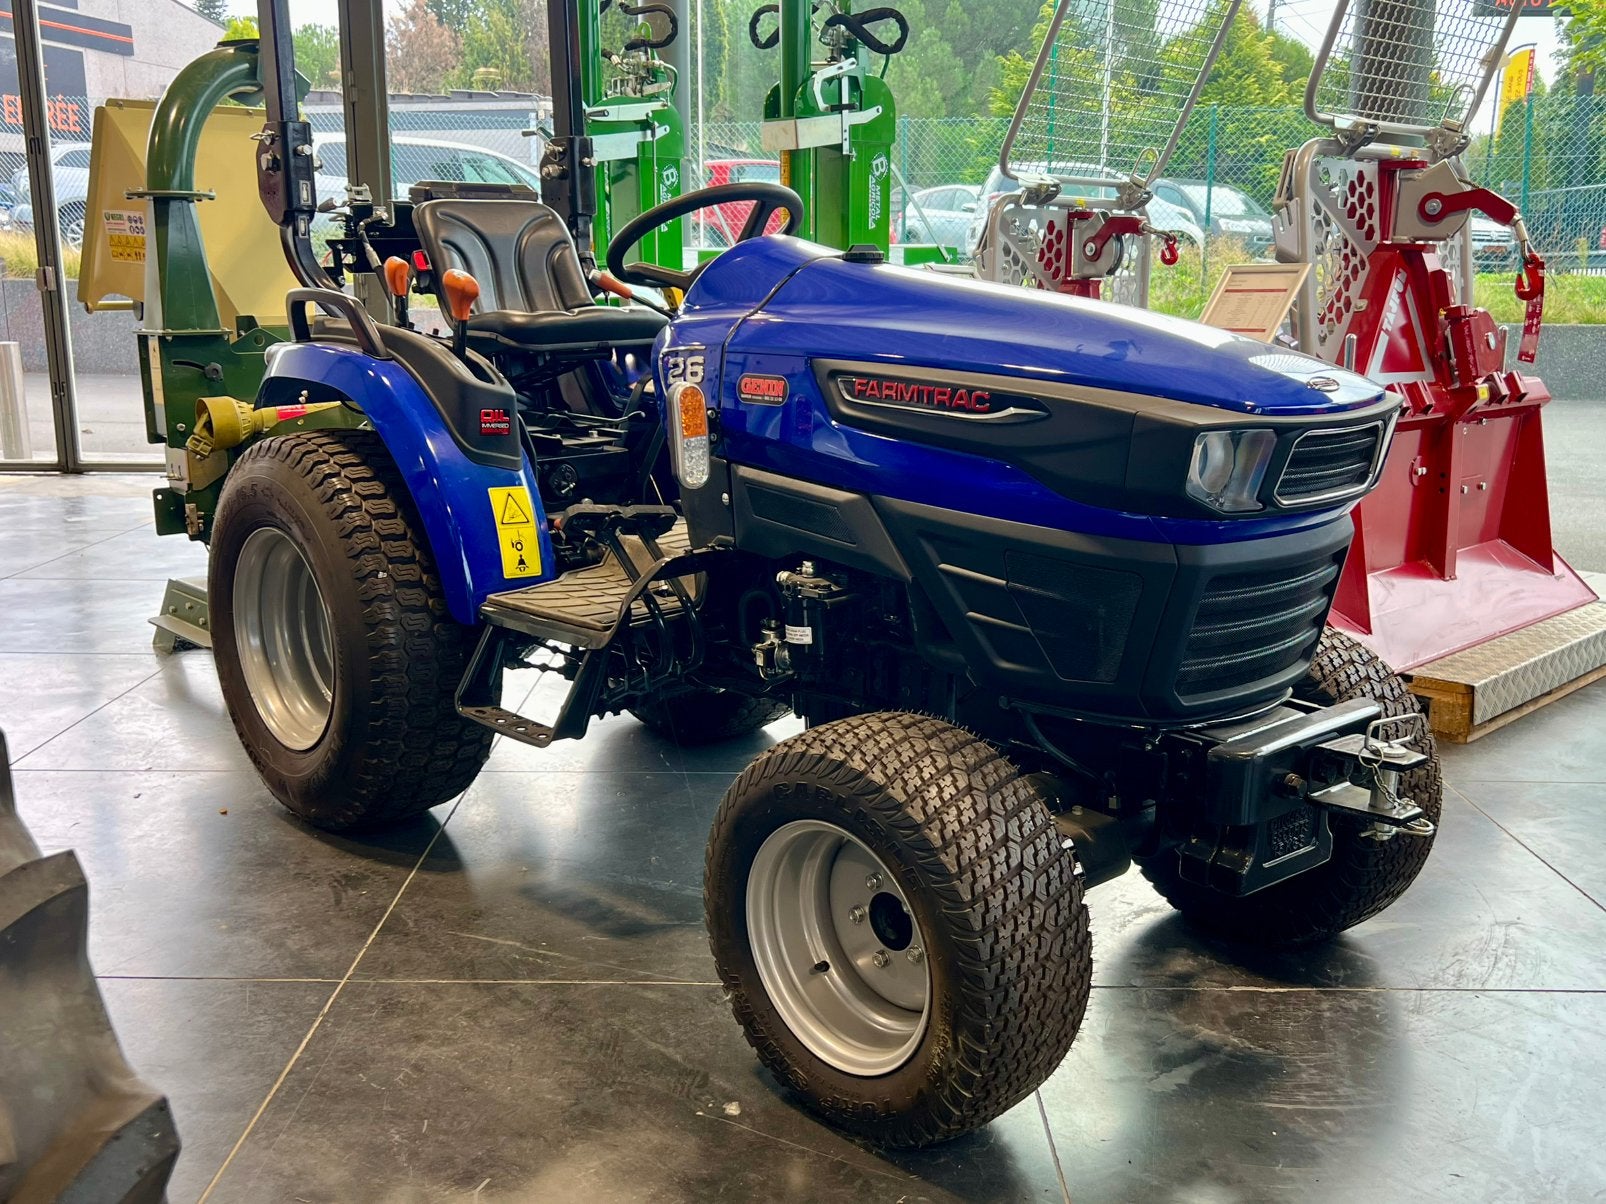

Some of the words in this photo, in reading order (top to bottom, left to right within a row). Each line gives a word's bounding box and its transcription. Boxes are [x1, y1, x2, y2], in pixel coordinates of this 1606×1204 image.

[3, 93, 81, 132] ERÉE
[1382, 268, 1407, 331] TAJFUN
[667, 355, 704, 384] 26
[741, 377, 785, 396] GENIN
[854, 377, 990, 412] FARMTRAC
[481, 409, 510, 422] OIL
[773, 781, 926, 892] CARLISLE
